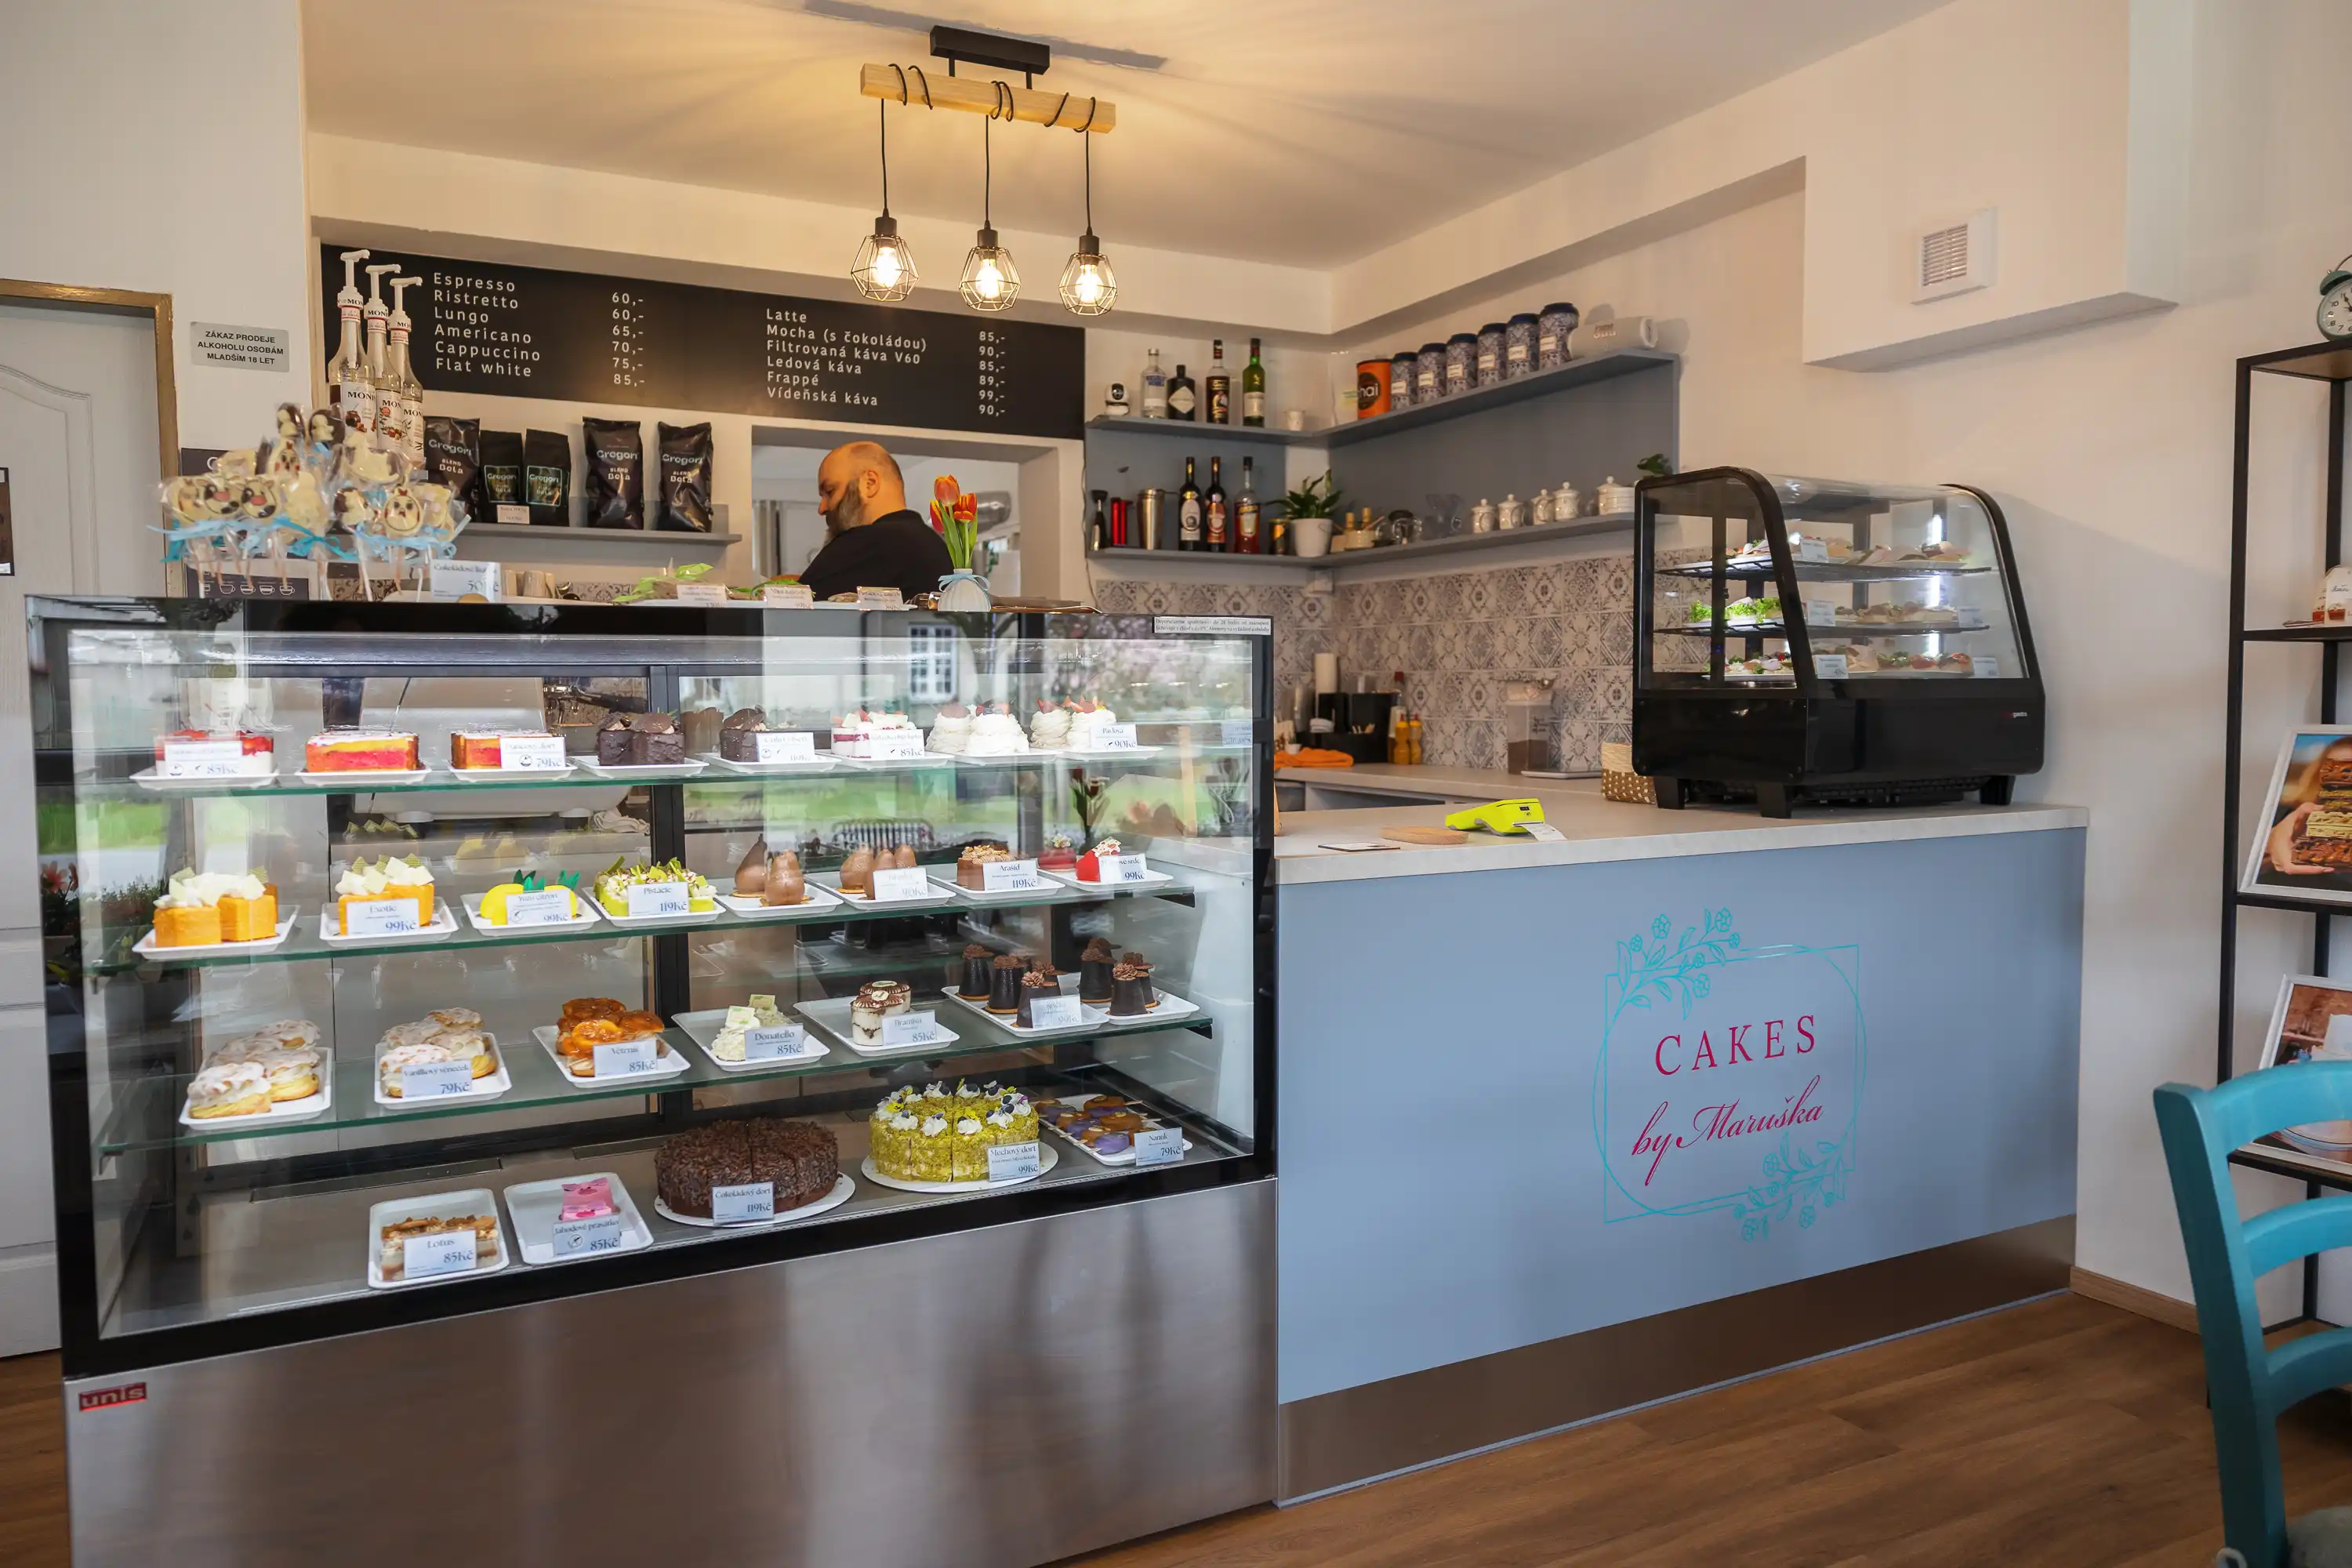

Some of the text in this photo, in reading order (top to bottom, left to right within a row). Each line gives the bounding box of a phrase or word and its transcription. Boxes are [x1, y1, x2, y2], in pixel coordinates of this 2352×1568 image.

[434, 272, 516, 292] Espresso
[434, 289, 518, 309] Ristretto
[612, 292, 644, 306] 60,-
[434, 307, 489, 325] Lungo
[612, 308, 644, 322] 60,-
[766, 308, 808, 323] Latte
[205, 330, 276, 343] ZÁKAZ PRODEJE
[434, 323, 532, 344] Americano
[612, 325, 644, 339] 65,-
[767, 324, 927, 353] Mocha (s čokoládou)
[978, 331, 1006, 345] 85,-
[198, 341, 284, 354] ALKOHOLU OSOBÁM
[435, 340, 541, 361] Cappuccino
[612, 340, 644, 355] 70,-
[767, 339, 920, 365] Filtrovaná káva V60
[978, 345, 1006, 359] 90,-
[207, 352, 246, 362] MLADŠÍM
[436, 358, 532, 376] Flat white
[612, 357, 644, 372] 75,-
[767, 355, 862, 374] Ledová káva
[978, 360, 1006, 374] 85,-
[613, 373, 645, 387] 85,-
[767, 371, 818, 387] Frappé
[978, 374, 1006, 389] 89,-
[348, 391, 376, 401] MONI
[767, 387, 878, 406] Vídeňská káva
[978, 389, 1006, 404] 99,-
[382, 399, 401, 408] MON
[403, 408, 423, 417] MON
[978, 404, 1006, 418] 90,-
[441, 458, 462, 466] BLEND
[1012, 878, 1036, 888] 119Kč
[660, 901, 688, 912] 119Kč
[385, 920, 416, 931] 99Kč
[755, 1029, 795, 1040] Donatello
[777, 1043, 802, 1054] 85Kč
[1655, 1014, 1816, 1075] CAKES
[629, 1061, 655, 1072] 85Kč
[440, 1082, 470, 1094] 79Kč
[1149, 1133, 1167, 1142] Nanuk
[1632, 1075, 1824, 1186] by Maruška
[1160, 1145, 1181, 1156] 79Kč
[1018, 1165, 1038, 1174] 99Kč
[747, 1202, 771, 1213] 119Kč
[427, 1239, 455, 1249] Lotus
[590, 1238, 619, 1251] 85Kč
[443, 1250, 474, 1264] 85Kč
